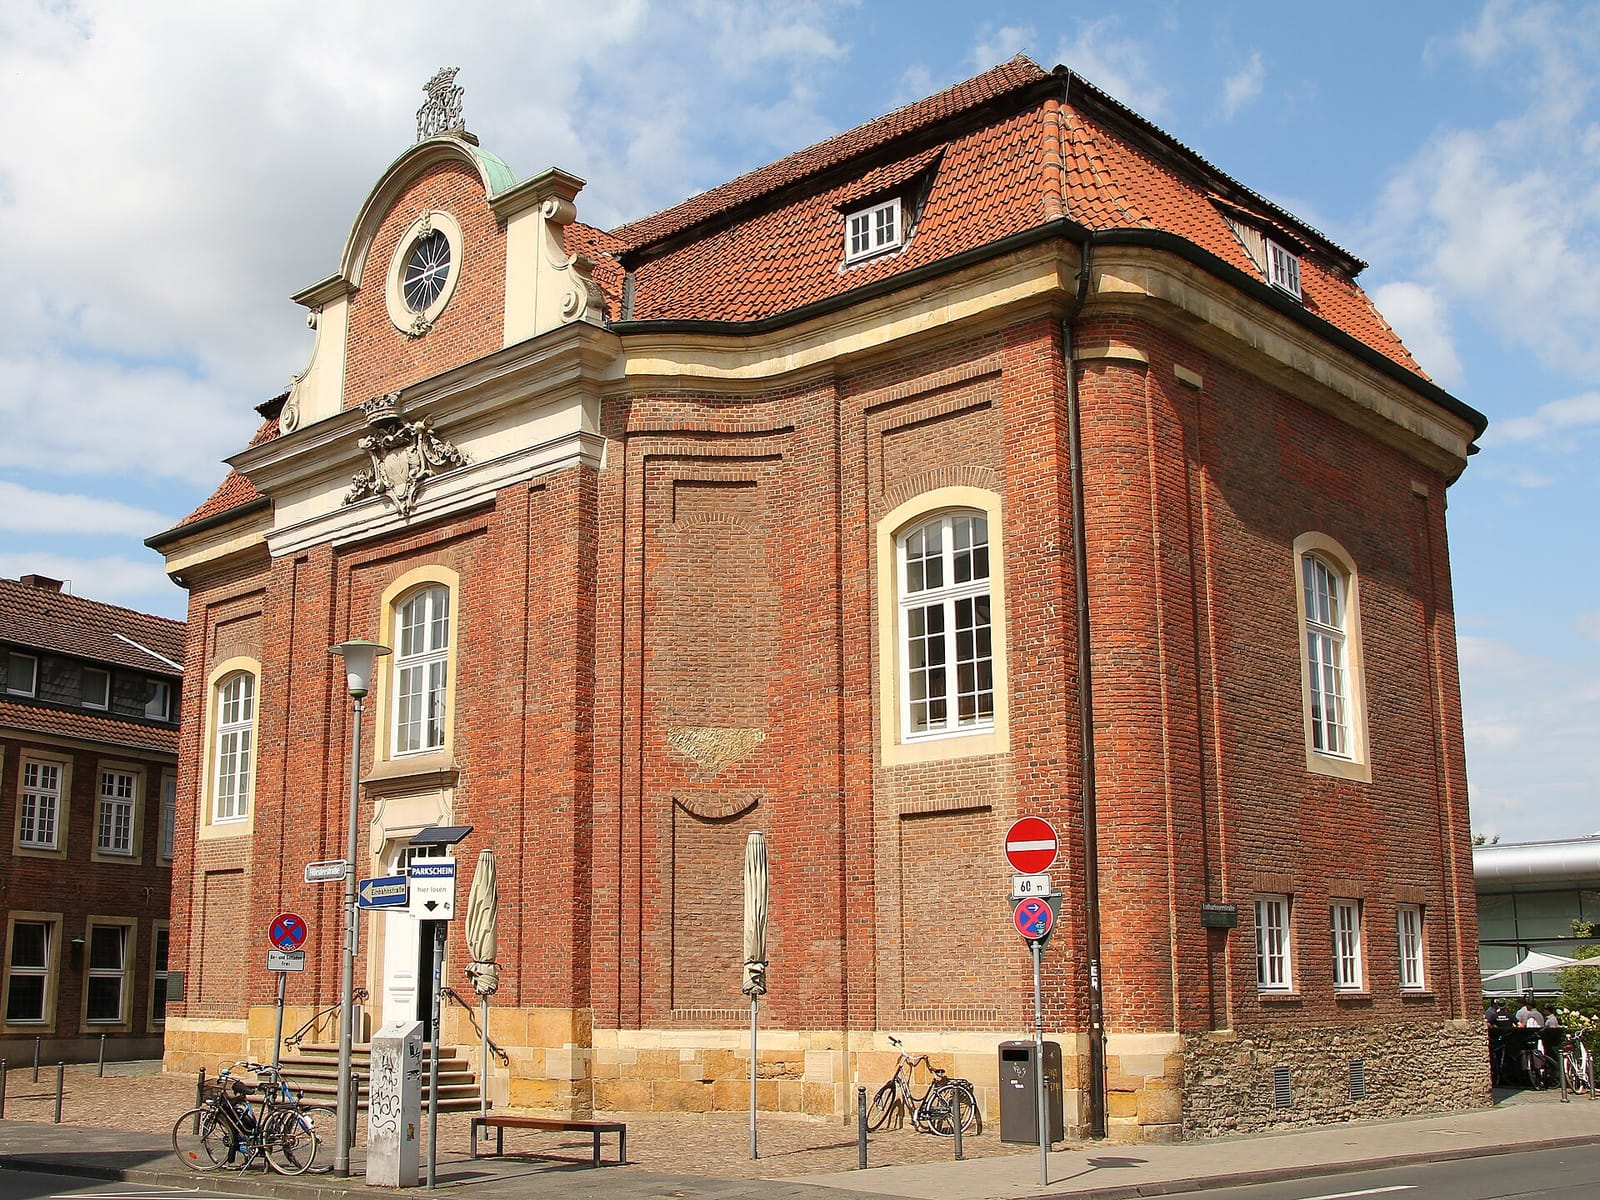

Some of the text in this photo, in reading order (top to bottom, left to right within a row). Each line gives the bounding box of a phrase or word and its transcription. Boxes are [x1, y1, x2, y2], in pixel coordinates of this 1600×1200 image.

[412, 866, 453, 876] PARKSCHEIN
[371, 886, 405, 896] Einbahnstraße
[1020, 880, 1031, 892] 60
